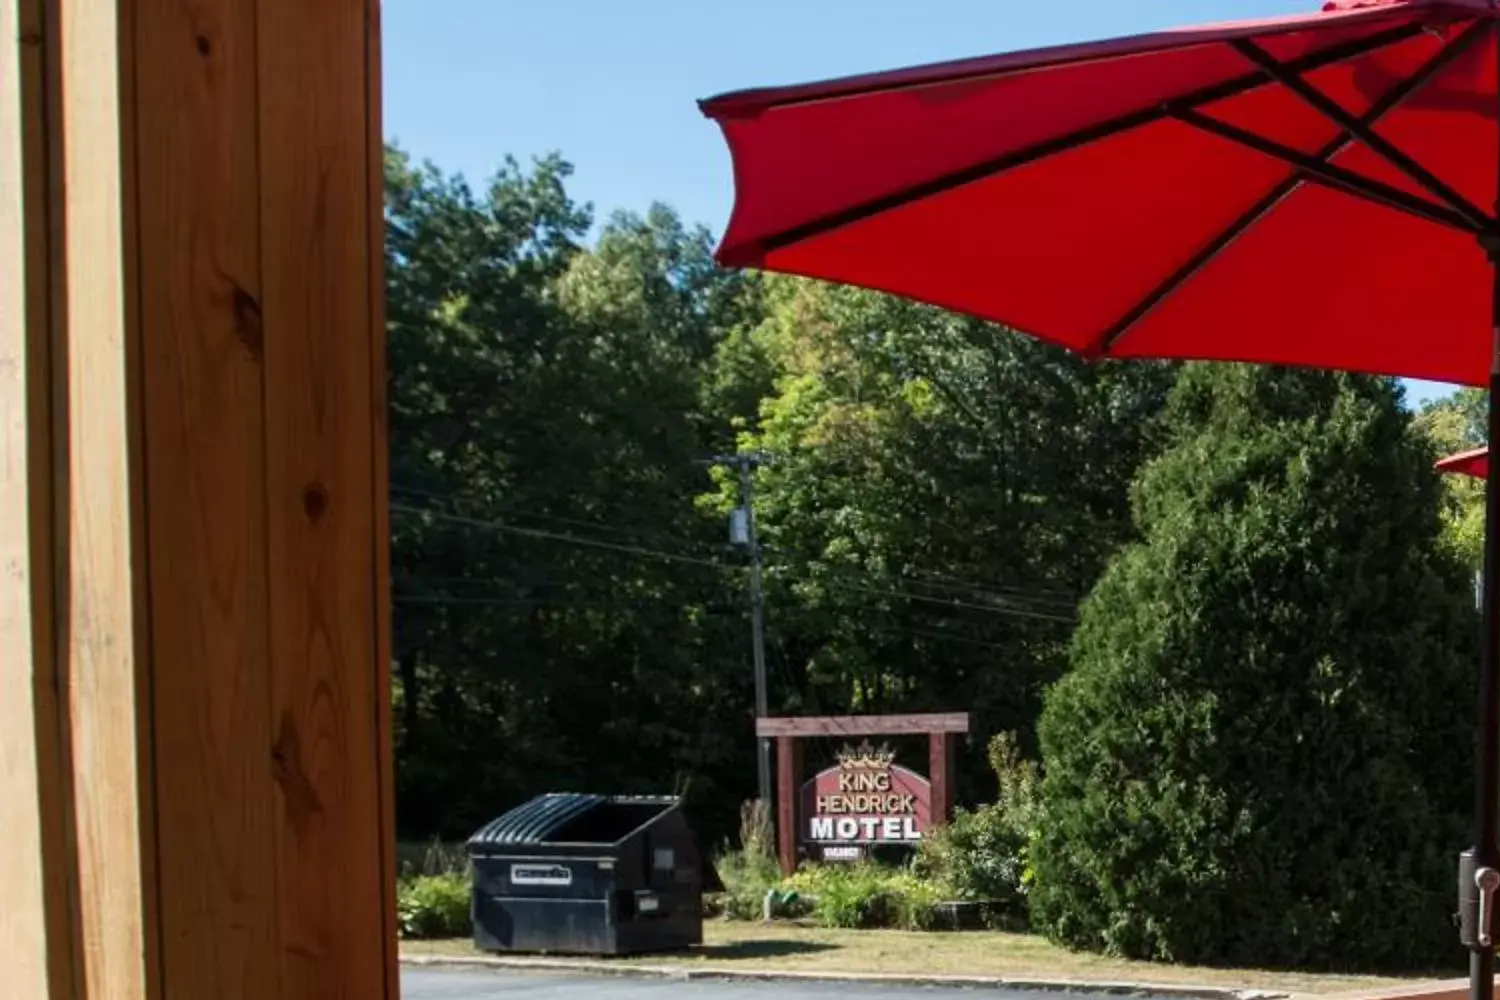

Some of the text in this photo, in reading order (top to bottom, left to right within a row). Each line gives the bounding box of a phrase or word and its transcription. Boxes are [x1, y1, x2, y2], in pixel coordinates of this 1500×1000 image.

[839, 773, 890, 791] KING
[816, 794, 914, 813] HENDRICK
[810, 817, 921, 839] MOTEL
